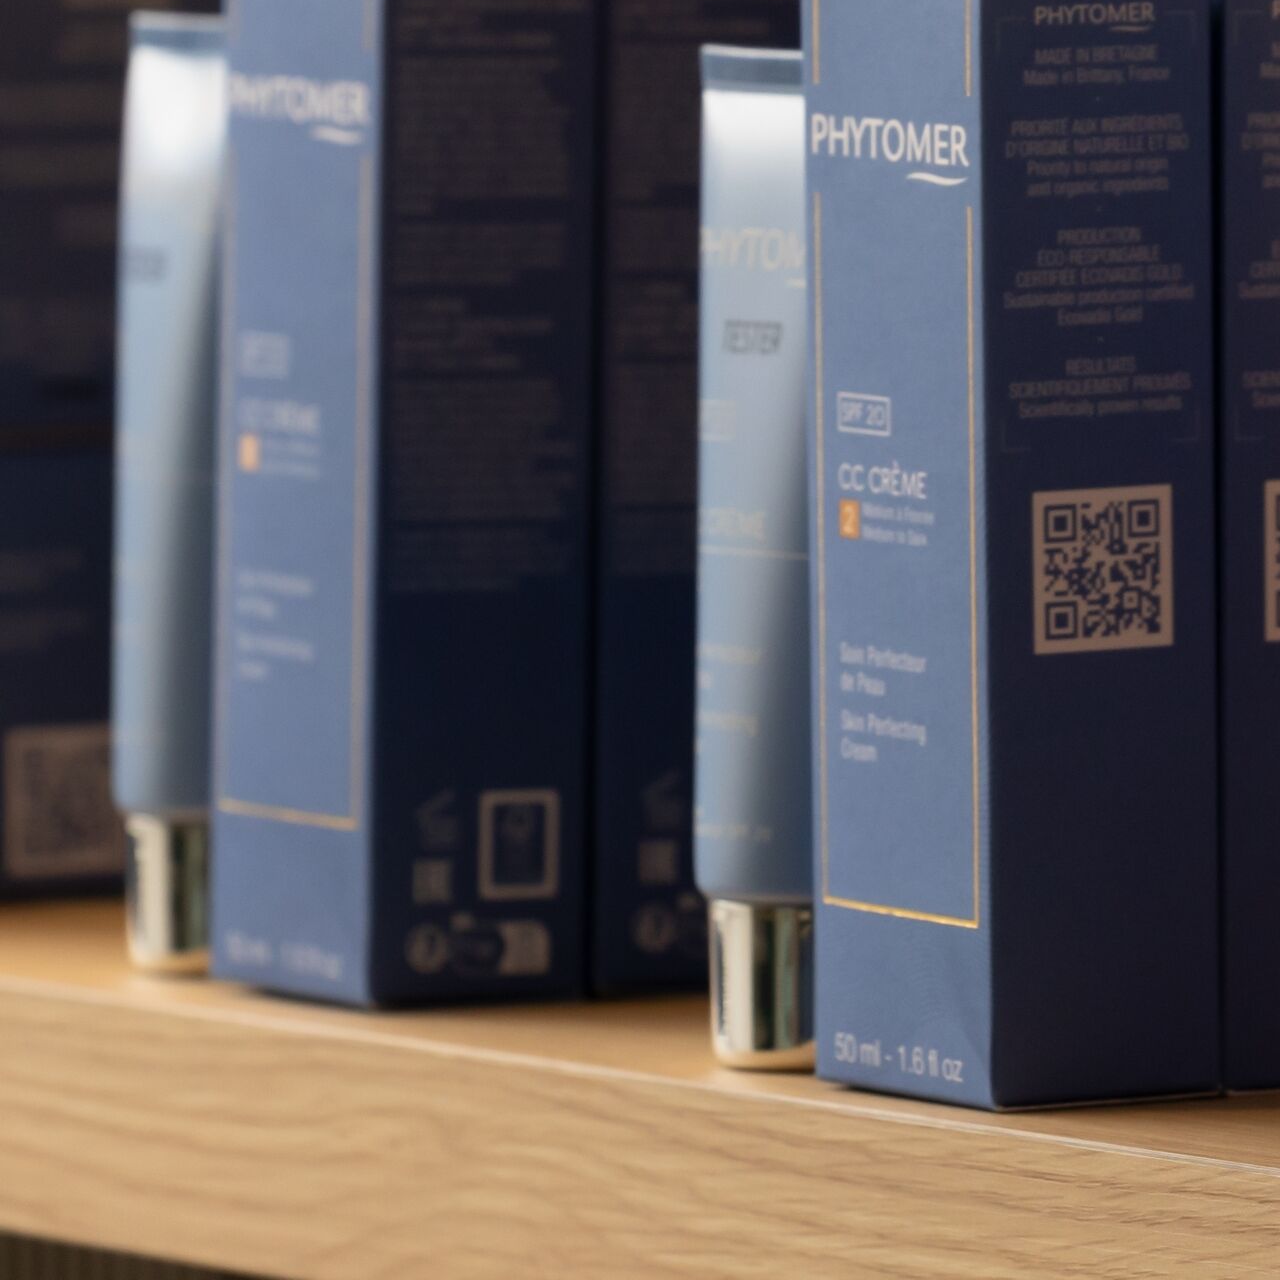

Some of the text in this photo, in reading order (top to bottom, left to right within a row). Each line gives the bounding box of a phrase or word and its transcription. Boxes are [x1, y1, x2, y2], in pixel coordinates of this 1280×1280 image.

[1033, 2, 1156, 25] PHYTOMER
[811, 114, 969, 166] PHYTOMER
[838, 459, 928, 500] CC CRÈME
[834, 1031, 855, 1063] 50
[859, 1039, 881, 1067] ml
[898, 1045, 924, 1075] 1.6
[941, 1058, 963, 1082] oz
